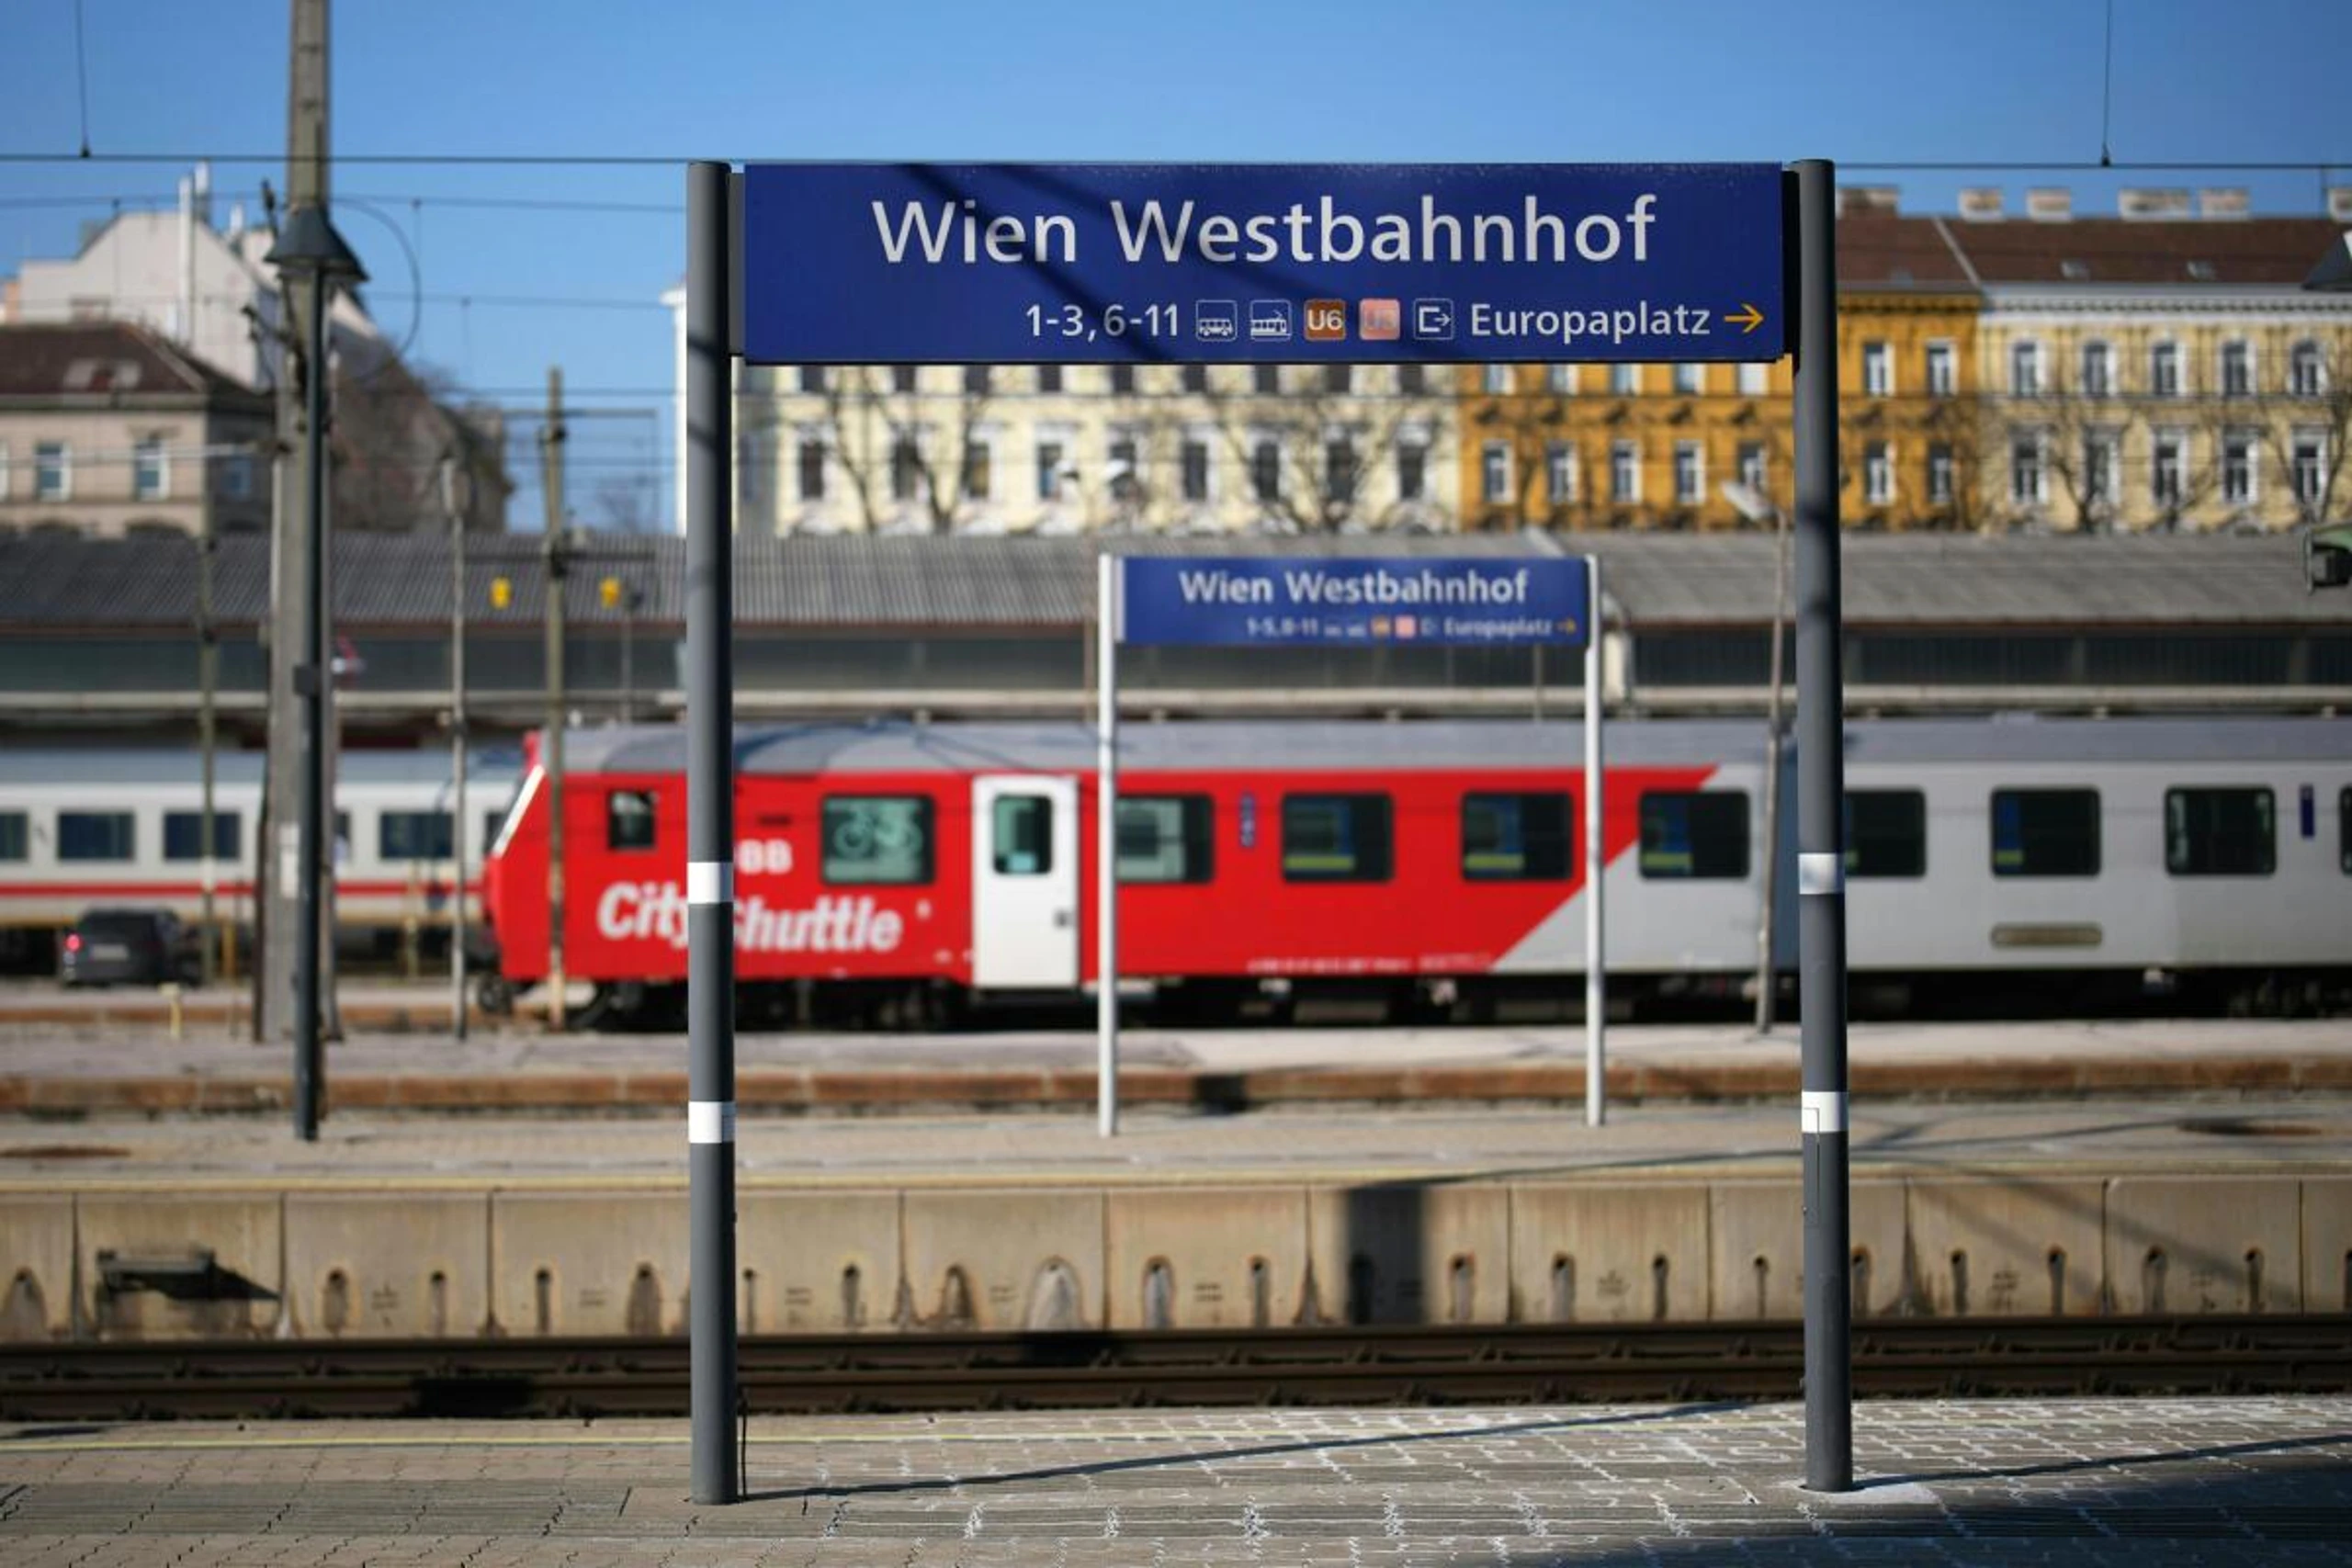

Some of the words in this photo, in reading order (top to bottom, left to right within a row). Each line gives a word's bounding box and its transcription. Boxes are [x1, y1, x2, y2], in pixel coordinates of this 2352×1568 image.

[872, 199, 1077, 264] Wien
[1111, 194, 1657, 264] Westbahnhof
[1308, 310, 1343, 332] U6
[1472, 300, 1711, 345] Europaplatz
[1179, 570, 1273, 604] Wien
[1284, 569, 1529, 604] Westbahnhof
